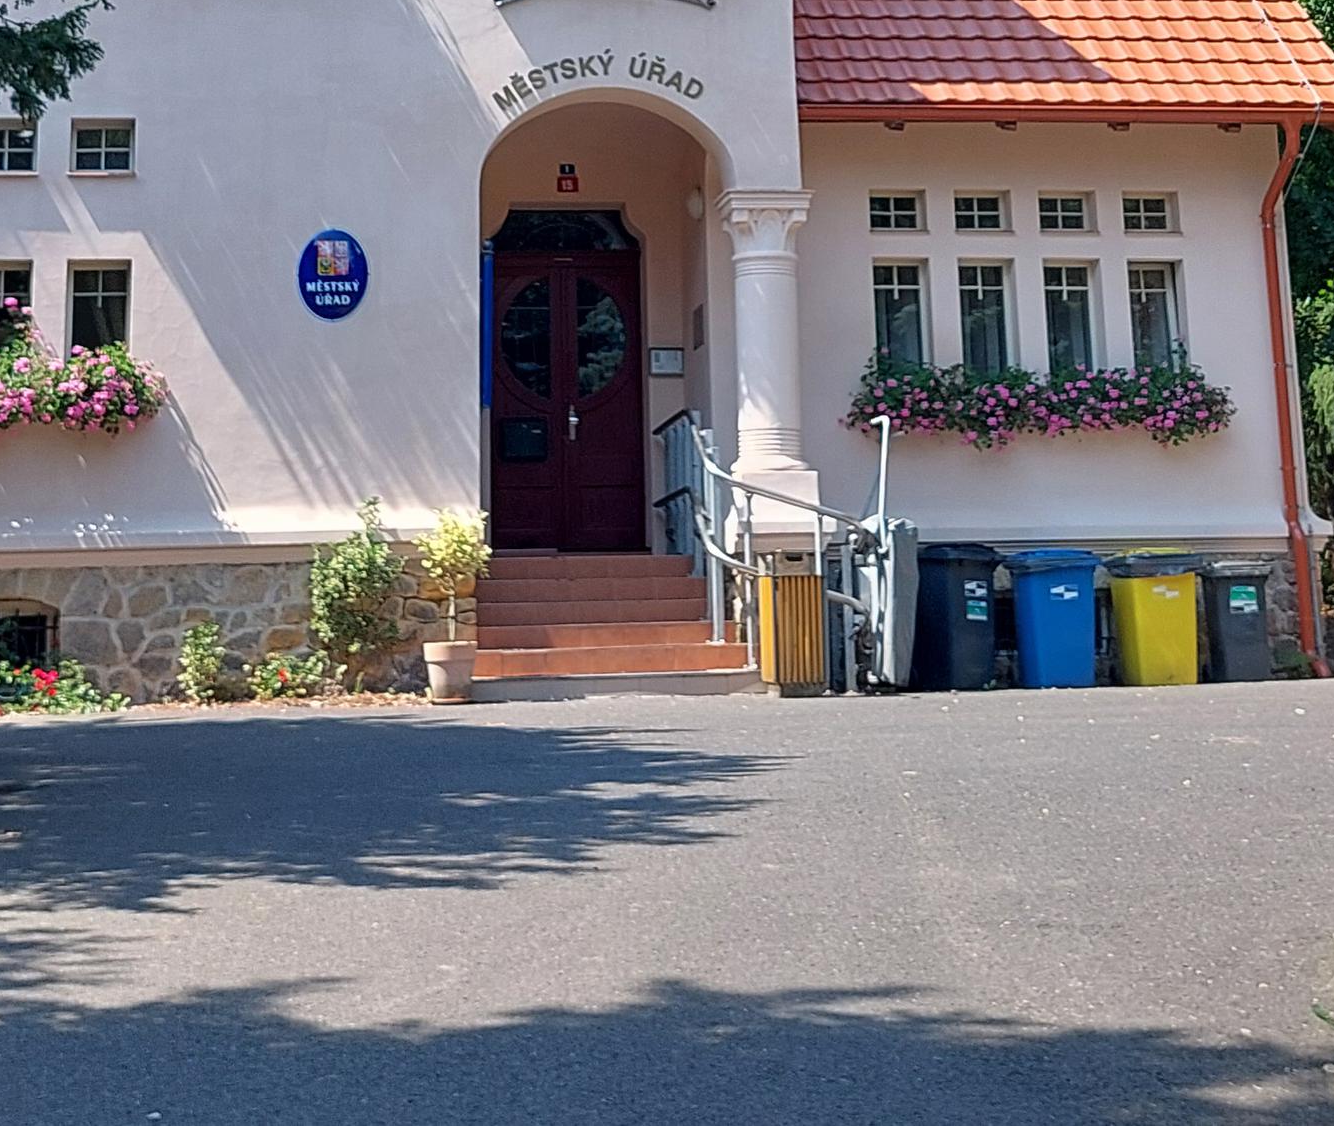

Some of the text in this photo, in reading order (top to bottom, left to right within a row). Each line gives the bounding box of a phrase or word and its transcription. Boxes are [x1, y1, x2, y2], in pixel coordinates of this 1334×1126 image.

[491, 48, 705, 113] MĚSTSKÝ ÚŘAD
[561, 179, 574, 191] 15
[305, 278, 360, 293] MĚSTSKÝ
[315, 293, 351, 306] ÚŘAD
